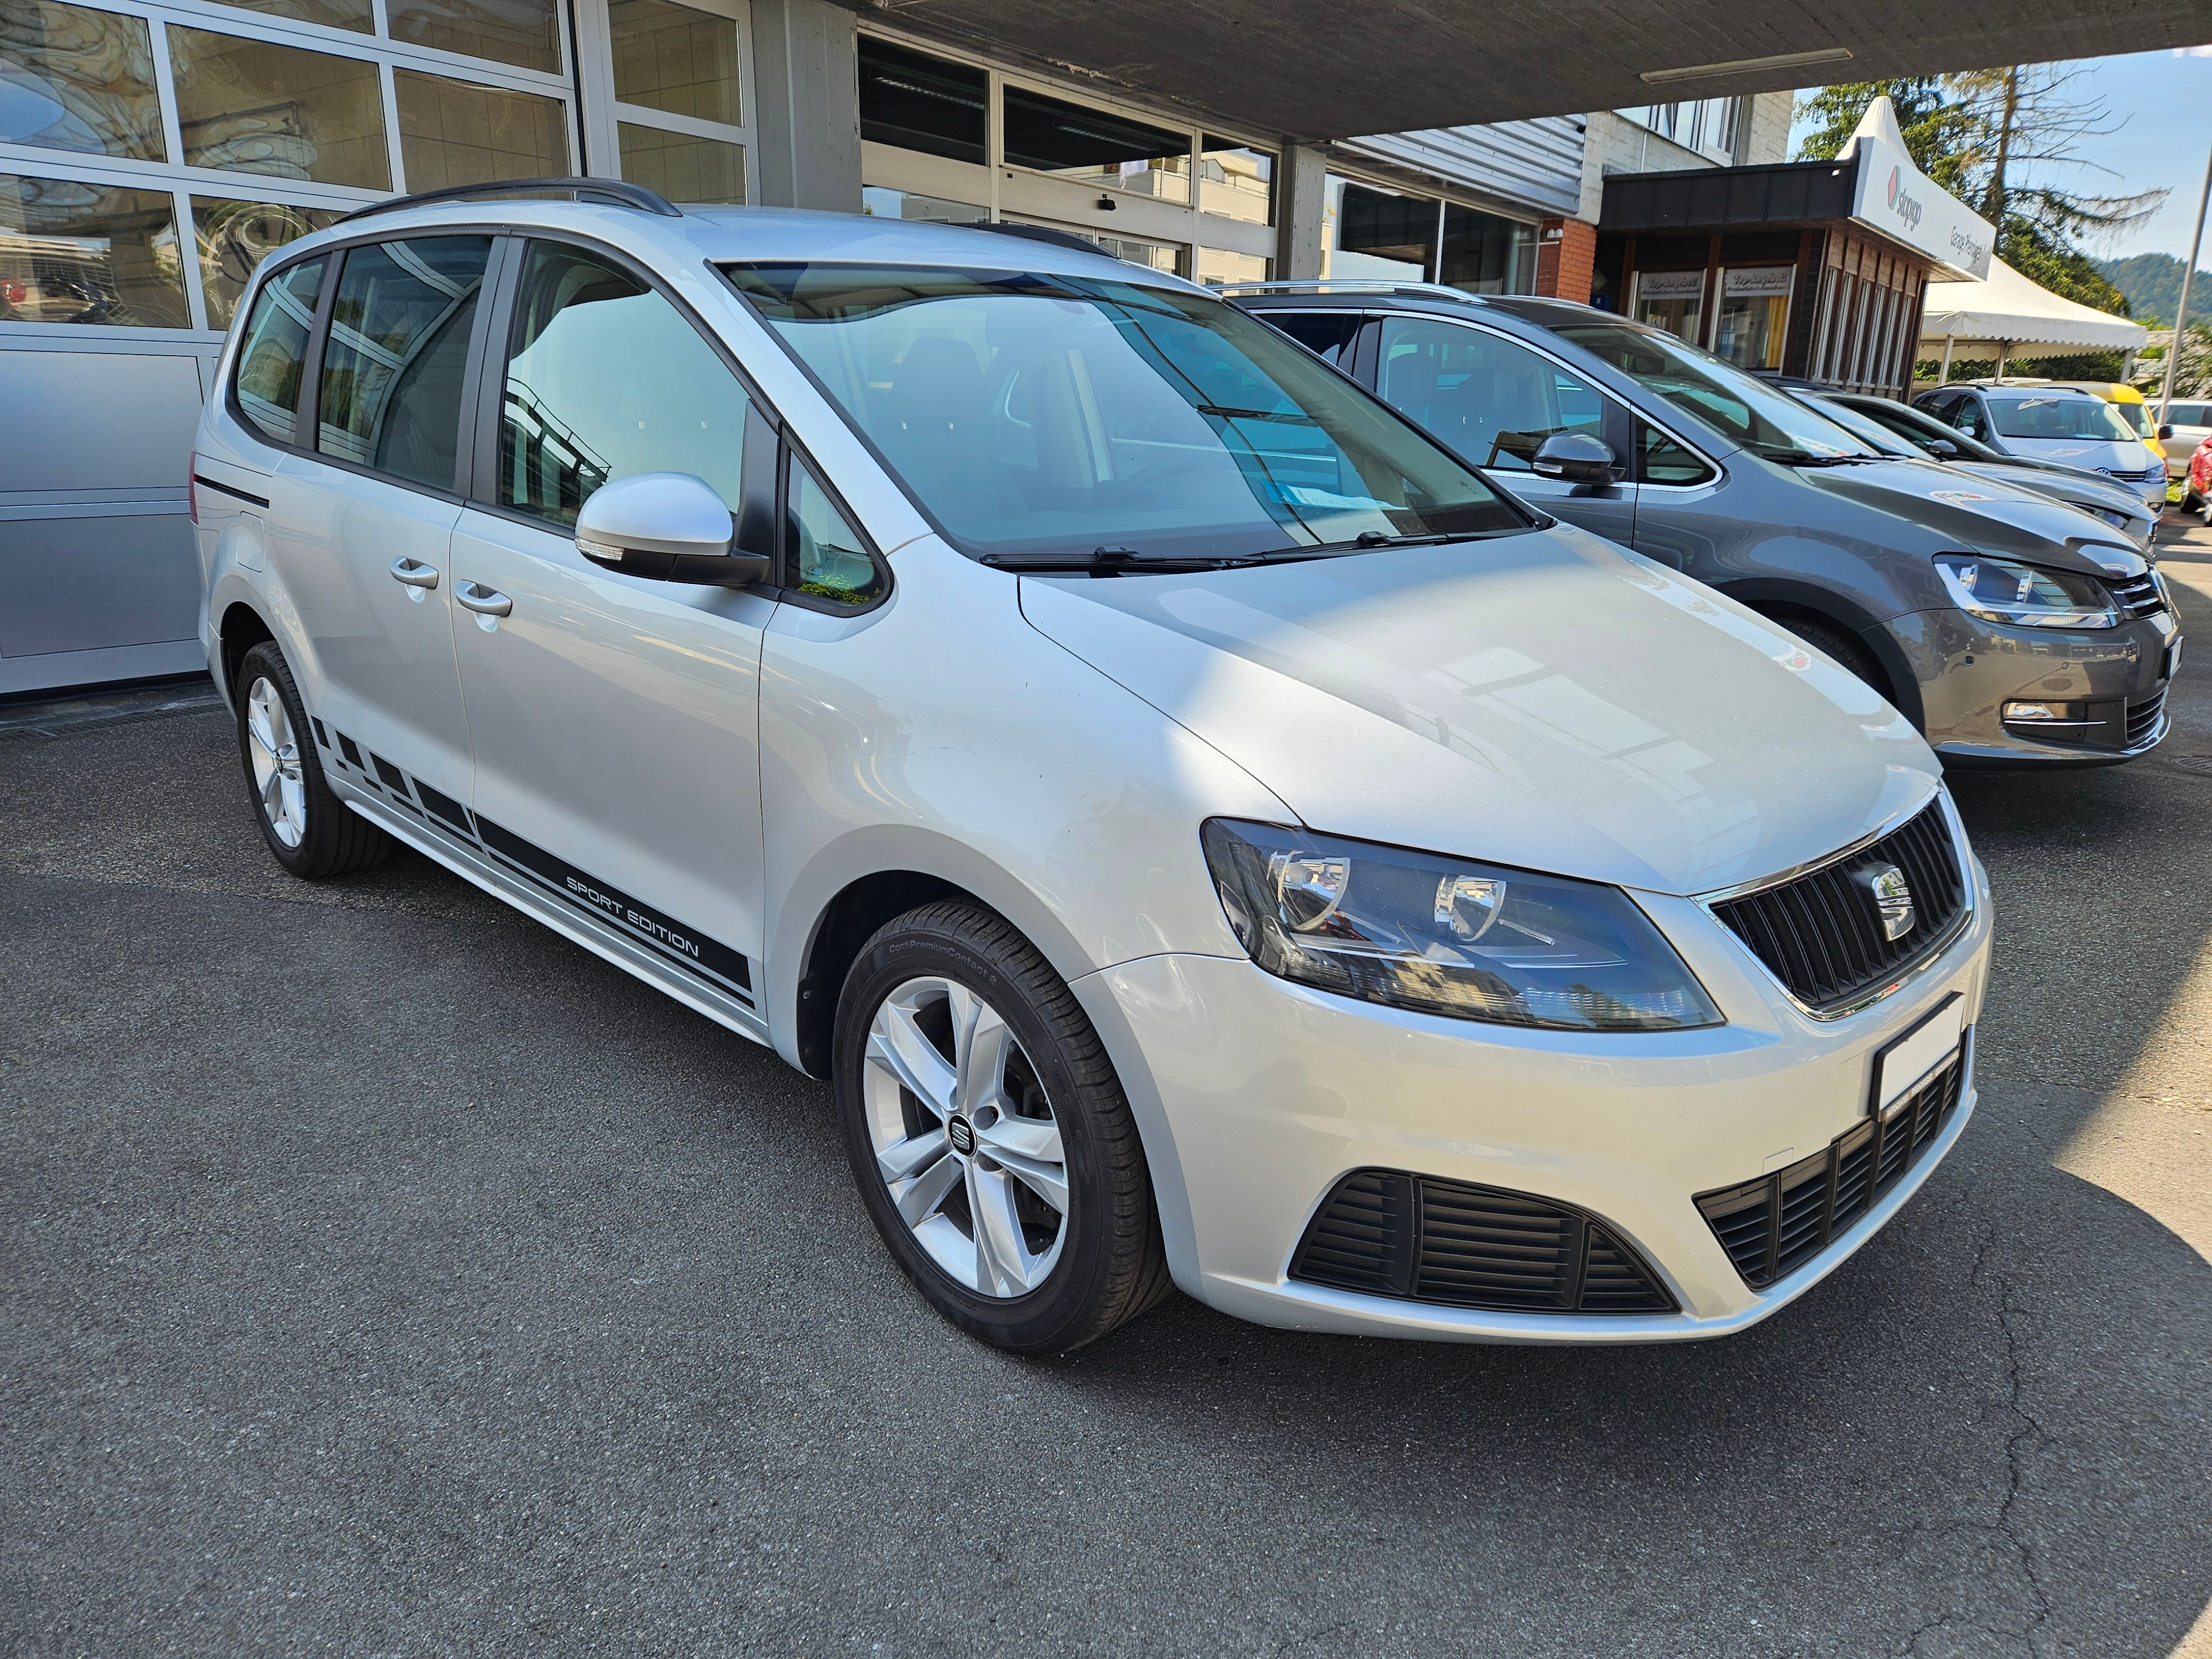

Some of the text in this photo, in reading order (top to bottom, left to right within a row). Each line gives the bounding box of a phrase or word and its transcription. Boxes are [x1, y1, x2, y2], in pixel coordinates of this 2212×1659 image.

[1950, 226, 1965, 255] Garage
[567, 877, 698, 957] SPORT EDITION
[889, 940, 987, 978] ContiPremiumContact
[990, 974, 997, 985] 2
